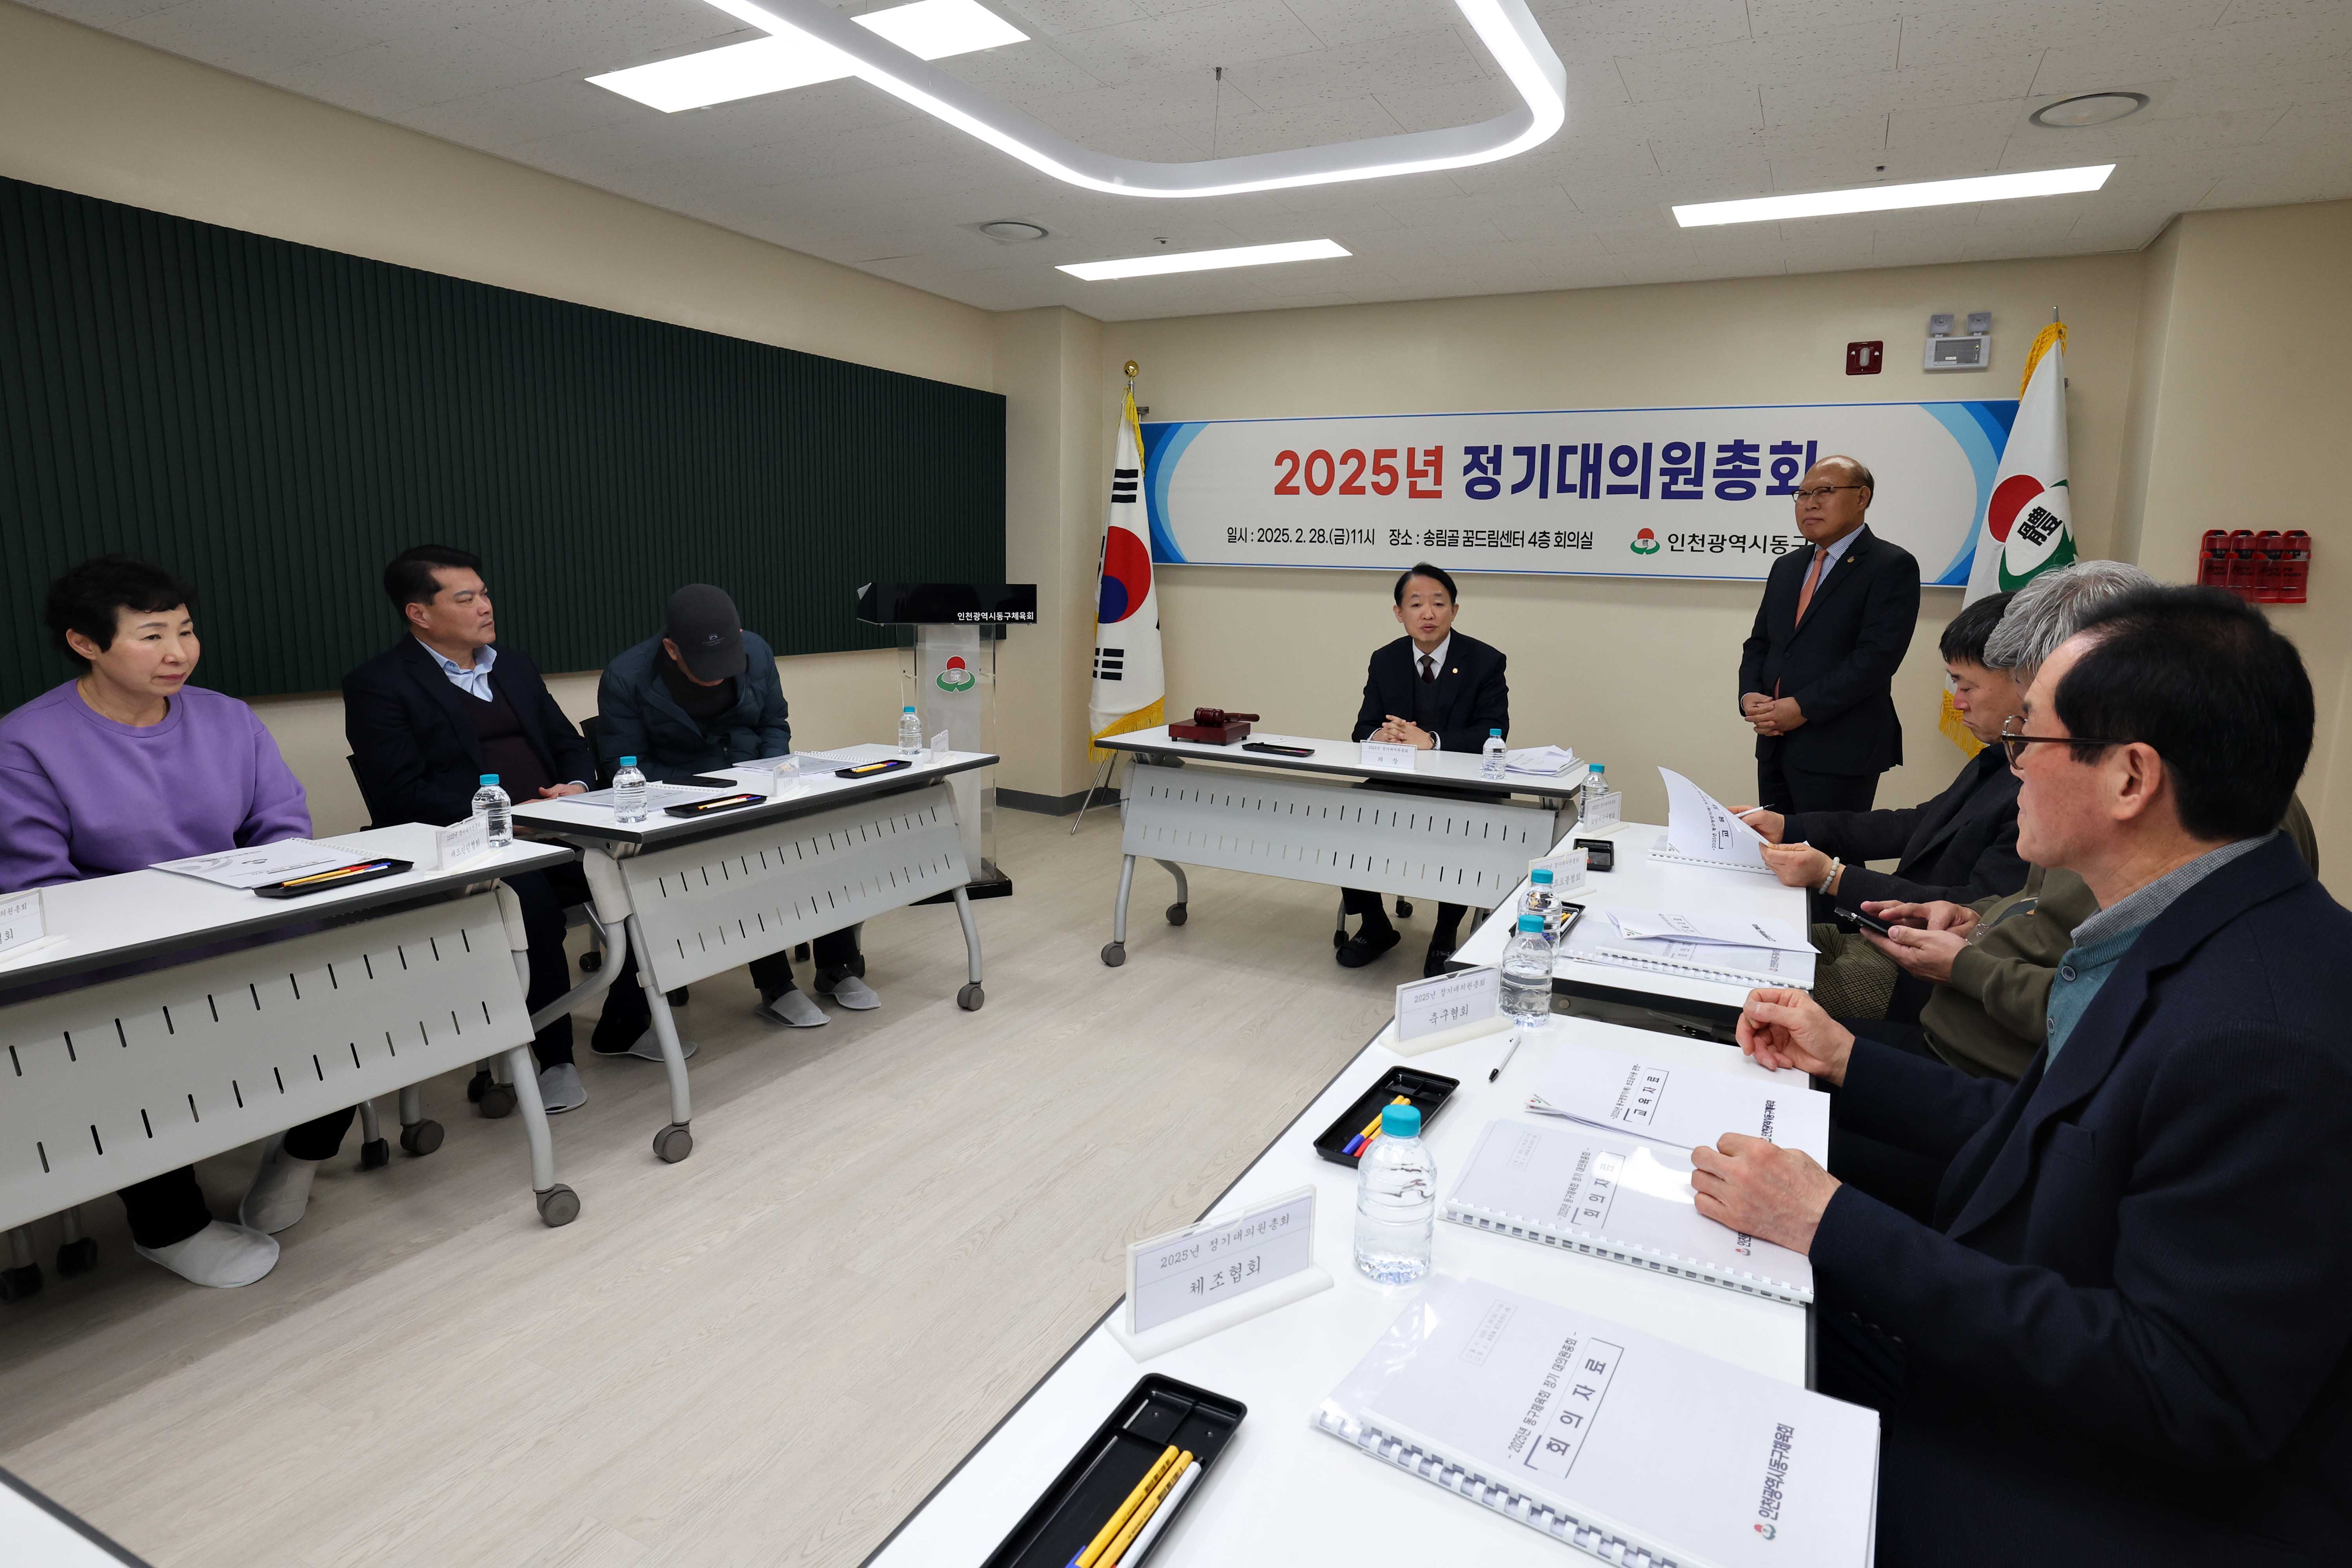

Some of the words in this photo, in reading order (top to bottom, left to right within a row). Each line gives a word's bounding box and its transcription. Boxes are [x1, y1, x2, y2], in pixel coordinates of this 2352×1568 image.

[1274, 445, 1443, 499] 2025년
[1463, 439, 1817, 501] 정기대의원총회
[1227, 527, 1248, 543] 일시
[1389, 529, 1412, 545] 장소
[1423, 529, 1459, 547] 송림골
[1463, 530, 1524, 548] 꿈드림센터
[1528, 530, 1551, 548] 4층
[1553, 531, 1593, 549] 회의실
[957, 611, 1034, 621] 인천광역시동구체육회
[1414, 991, 1436, 1004] 2025년
[1440, 978, 1485, 997] 정기대의원총회
[1429, 1004, 1468, 1025] 축구협회
[1161, 1244, 1200, 1269] 2025년
[1208, 1213, 1289, 1251] 정기대의원총회
[1189, 1256, 1261, 1296] 체조협회
[1508, 1427, 1532, 1453] 2025년
[1523, 1389, 1552, 1426] 동구체육회
[1543, 1373, 1560, 1388] 정기
[1552, 1338, 1577, 1372] 대의원총회
[1758, 1423, 1795, 1521] 인천광역시동구체육회
